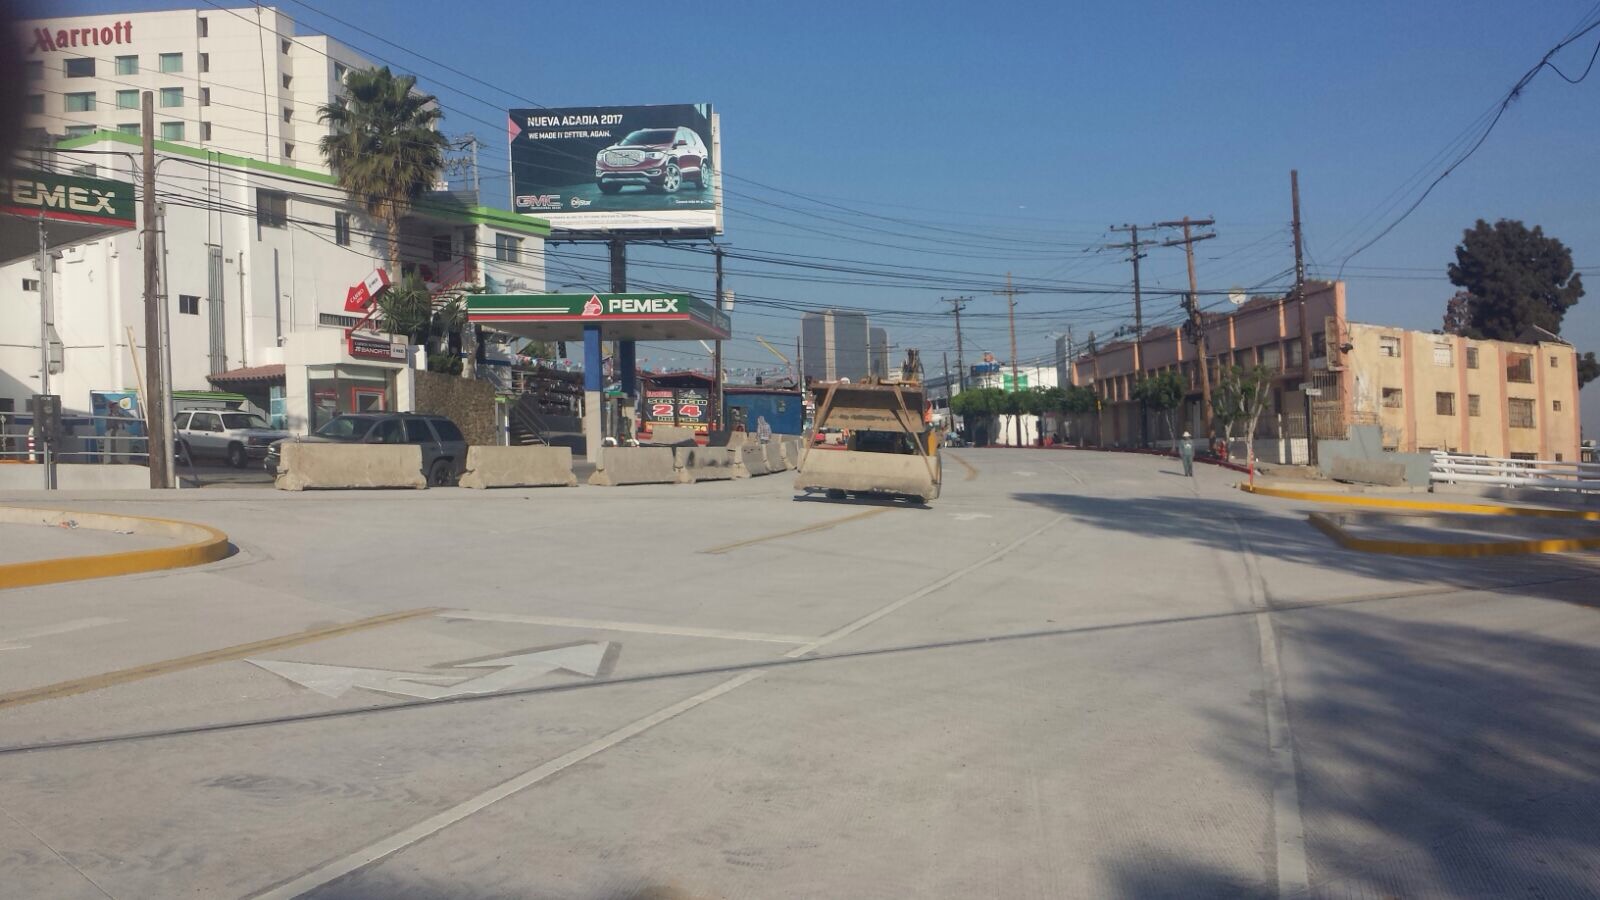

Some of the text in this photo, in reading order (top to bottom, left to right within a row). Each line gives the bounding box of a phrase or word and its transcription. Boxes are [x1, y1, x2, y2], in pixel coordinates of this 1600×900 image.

[28, 20, 133, 53] Marriott
[527, 114, 623, 127] NUEVA ACADIA 2017
[528, 132, 539, 140] WE
[0, 178, 116, 215] EMEX
[516, 194, 561, 207] GMC
[608, 298, 679, 313] PEMEX
